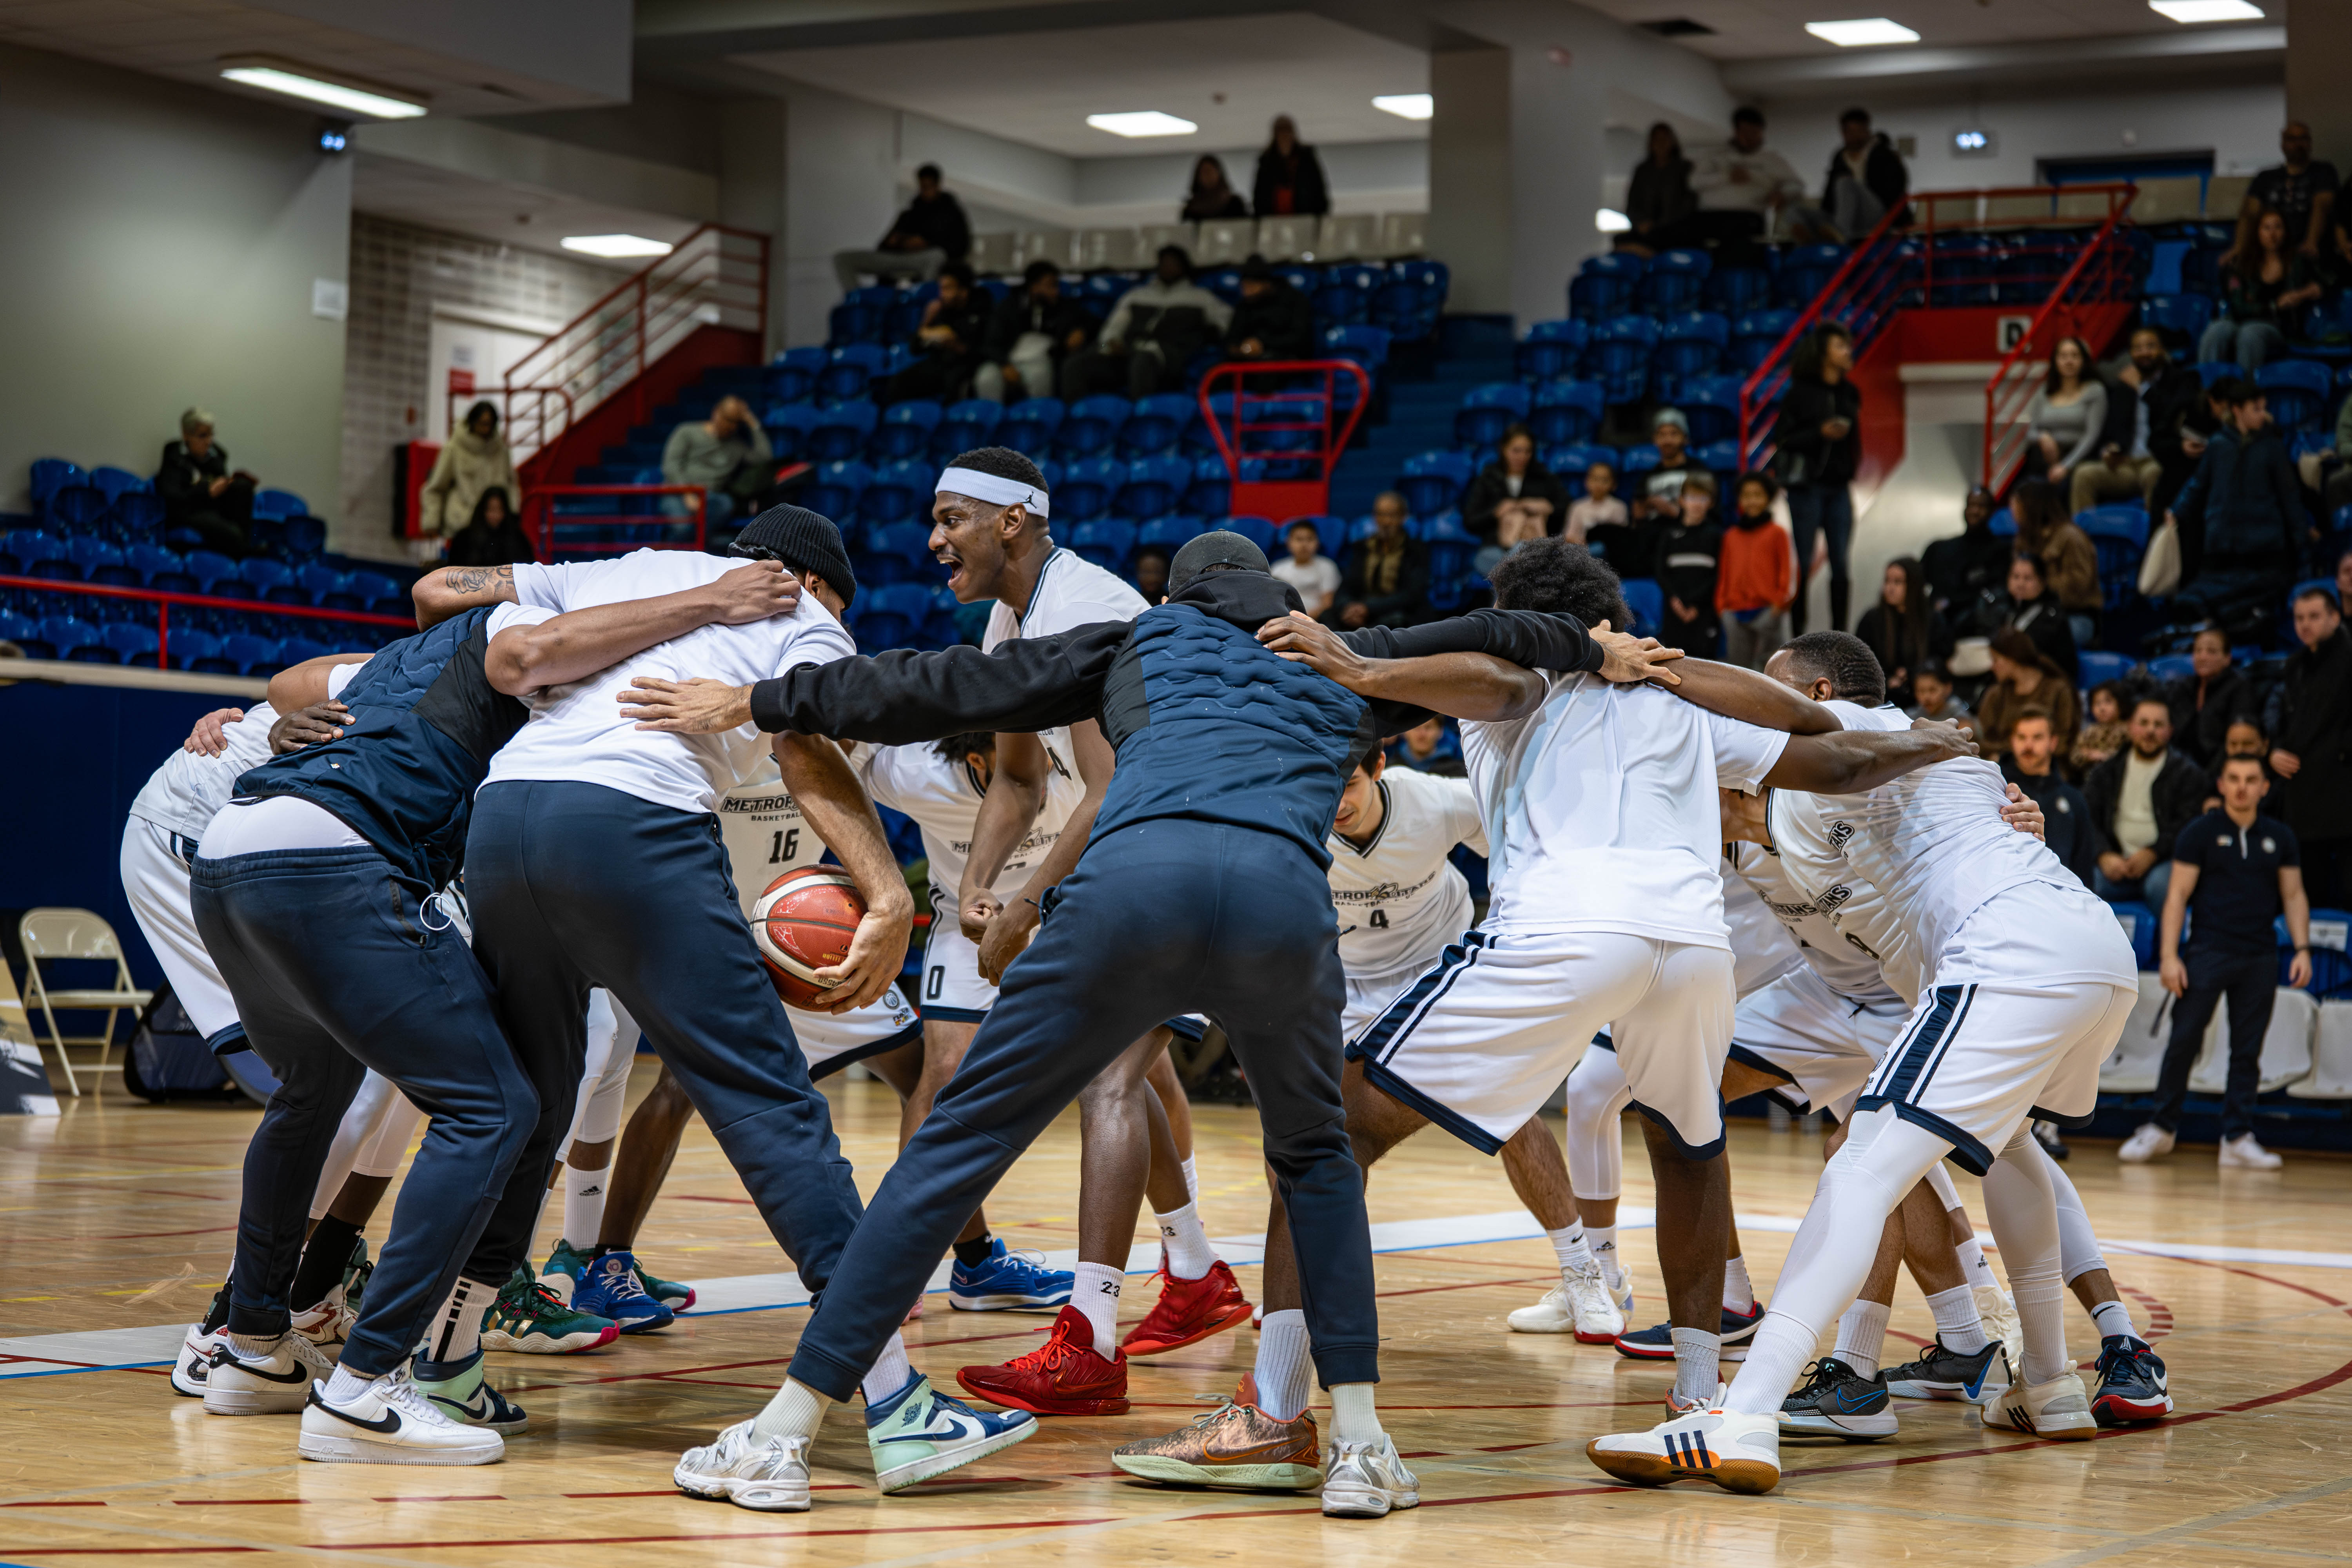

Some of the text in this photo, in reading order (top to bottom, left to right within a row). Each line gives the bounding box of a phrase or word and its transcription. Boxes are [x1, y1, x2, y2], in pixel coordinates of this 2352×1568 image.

[722, 795, 796, 813] METROP
[769, 828, 800, 864] 16
[1370, 909, 1390, 929] 4
[927, 965, 946, 1000] 0
[1101, 1281, 1120, 1298] 23
[714, 1444, 728, 1464] N
